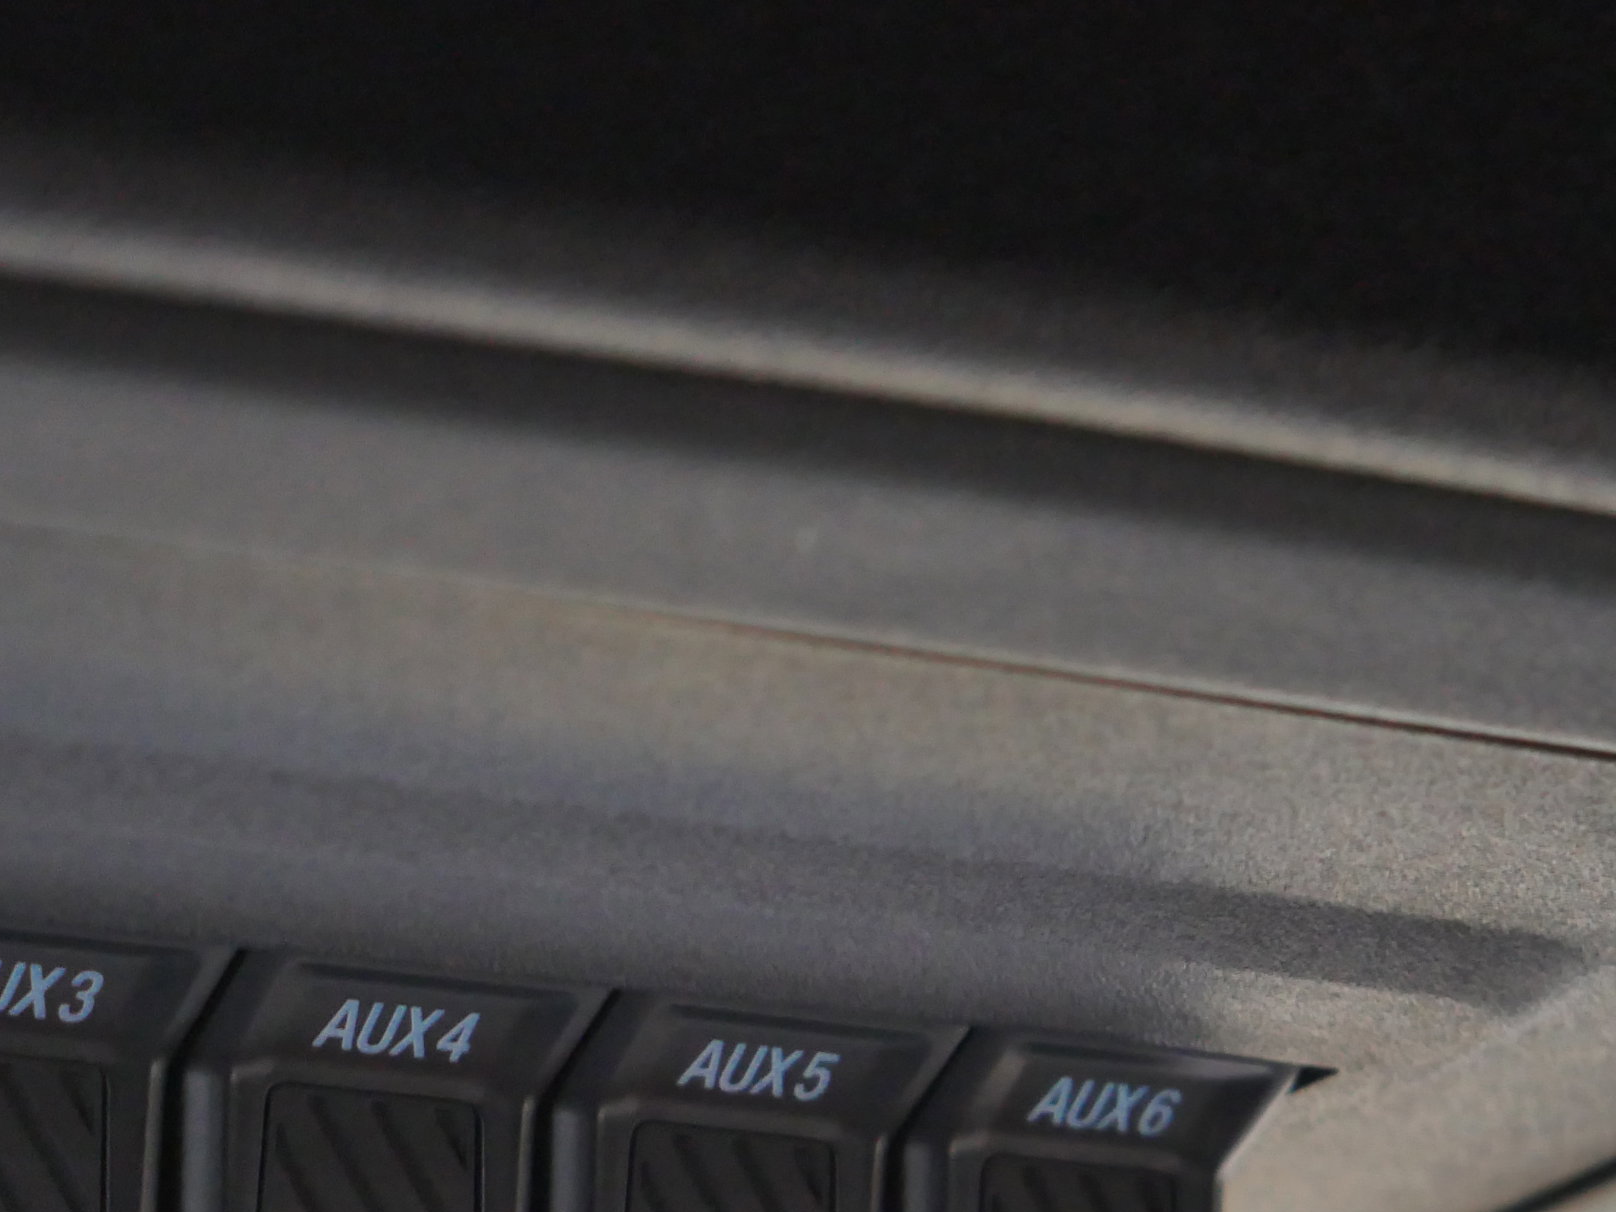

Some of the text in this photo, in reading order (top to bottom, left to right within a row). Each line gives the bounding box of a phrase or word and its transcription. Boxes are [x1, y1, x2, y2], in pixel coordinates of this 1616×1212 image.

[312, 998, 481, 1063] AUX4
[676, 1039, 841, 1101] AUX5
[1027, 1076, 1181, 1138] AUX6
